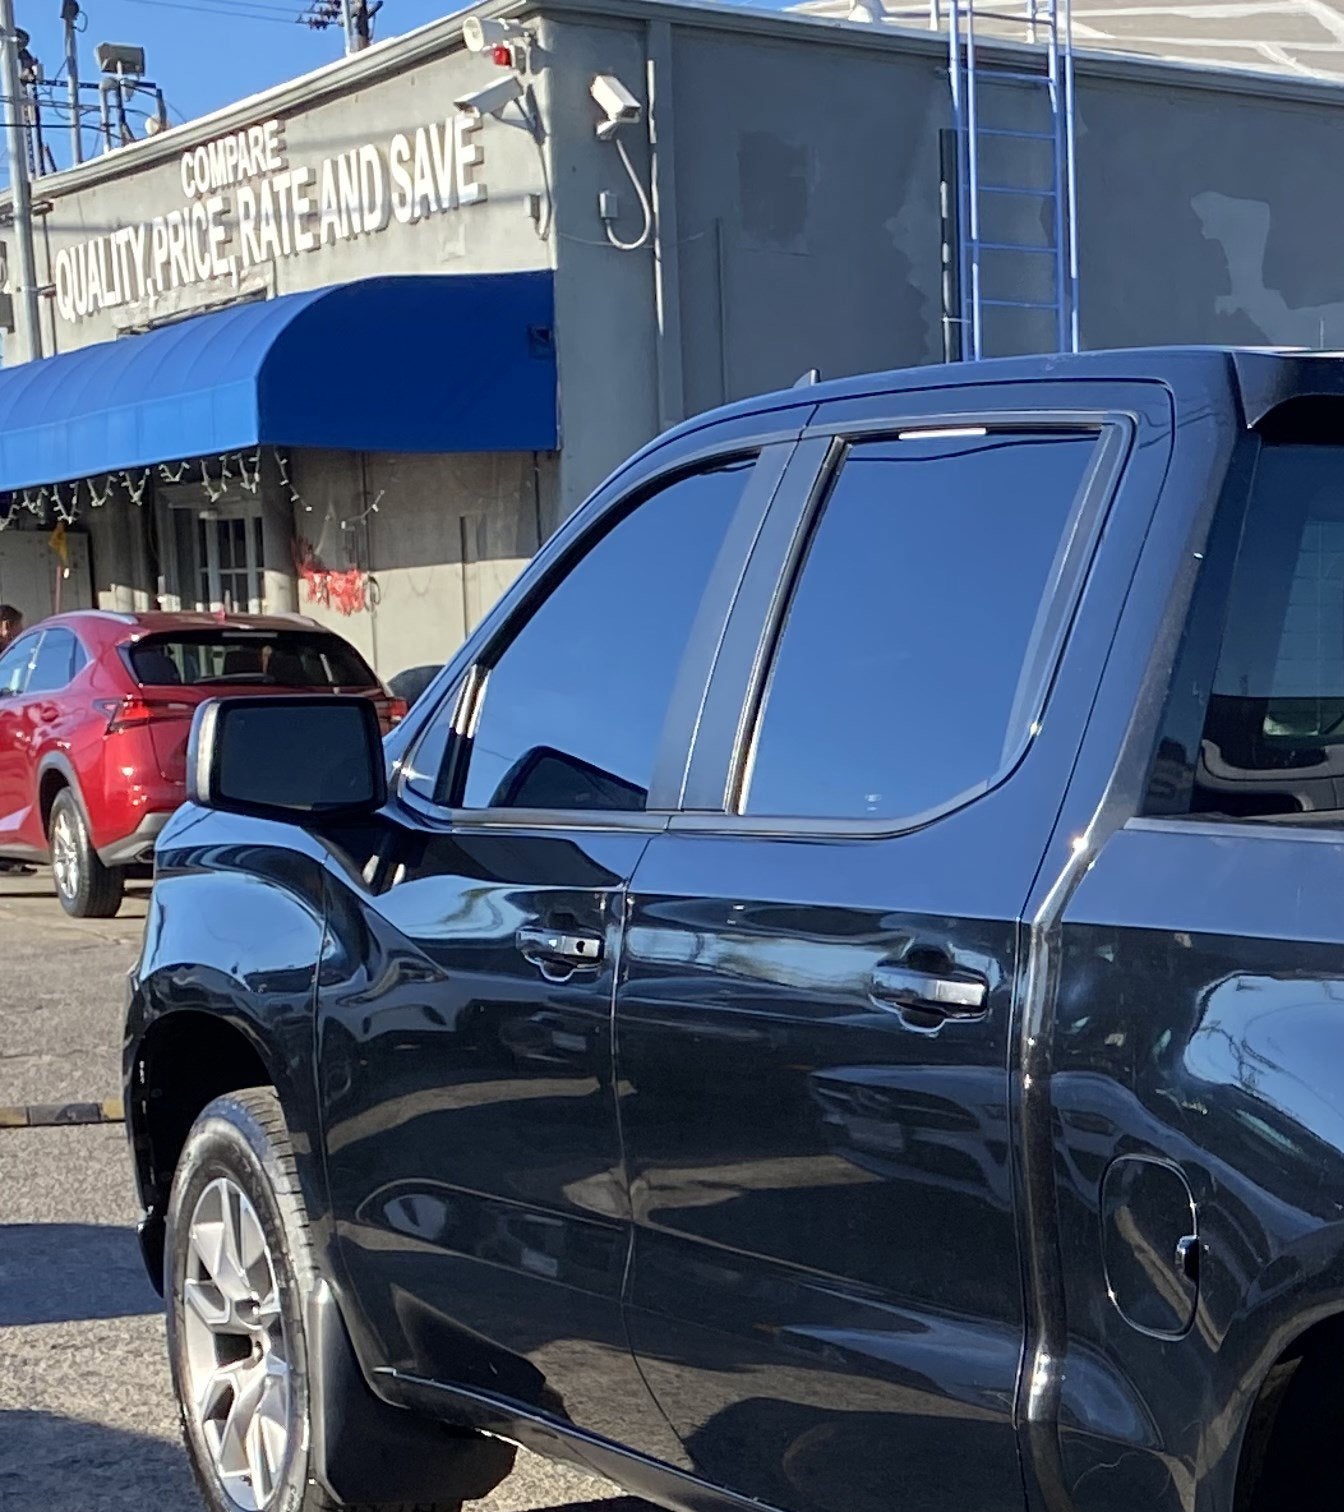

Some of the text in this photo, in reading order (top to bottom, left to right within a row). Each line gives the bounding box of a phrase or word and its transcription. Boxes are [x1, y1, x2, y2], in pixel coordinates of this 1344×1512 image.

[180, 119, 283, 198] COMPARE
[236, 166, 314, 268] RATE
[320, 143, 383, 245] AND
[391, 111, 479, 224] SAVE
